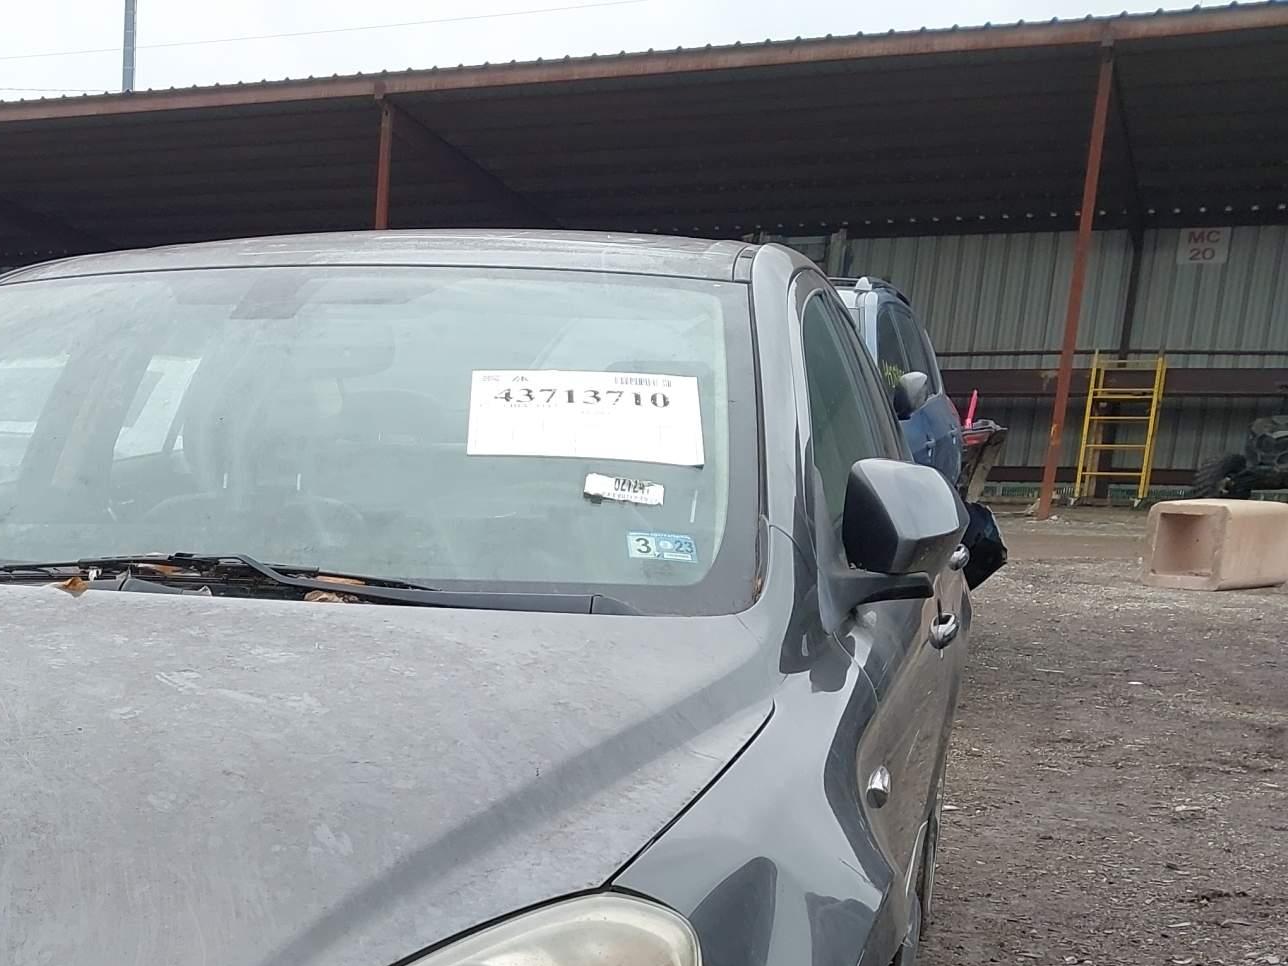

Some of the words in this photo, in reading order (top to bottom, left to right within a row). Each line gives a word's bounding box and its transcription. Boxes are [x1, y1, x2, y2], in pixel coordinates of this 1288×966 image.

[1188, 230, 1221, 243] MC
[1189, 248, 1215, 260] 20
[494, 388, 670, 408] 43713710
[635, 537, 652, 554] 3
[674, 540, 694, 553] 23
